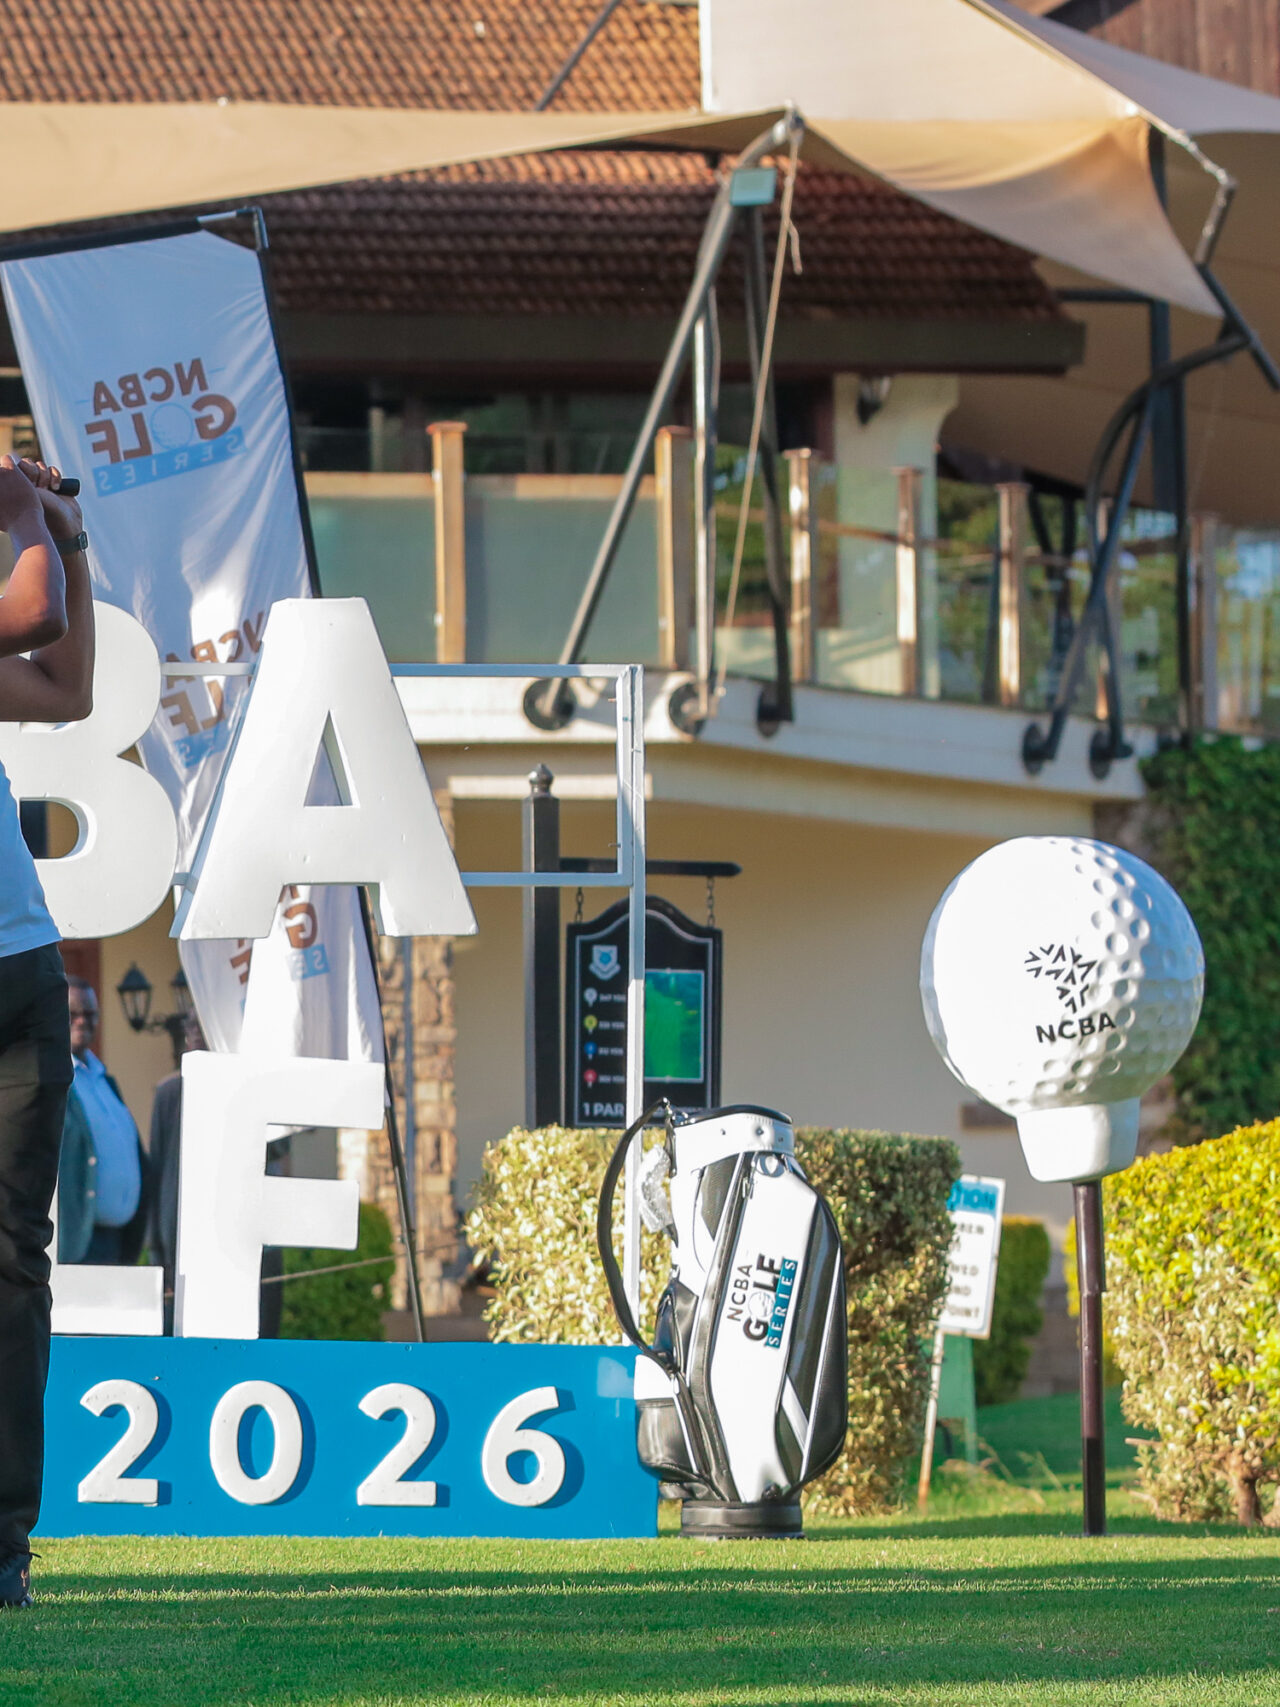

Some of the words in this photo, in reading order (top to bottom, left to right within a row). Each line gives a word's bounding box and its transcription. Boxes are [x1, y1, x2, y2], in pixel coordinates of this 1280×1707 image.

[1035, 1011, 1117, 1043] NCBA
[726, 1264, 753, 1322] NCBA
[743, 1253, 782, 1342] GOLF
[767, 1260, 796, 1346] SERIES
[77, 1377, 567, 1508] 2026
